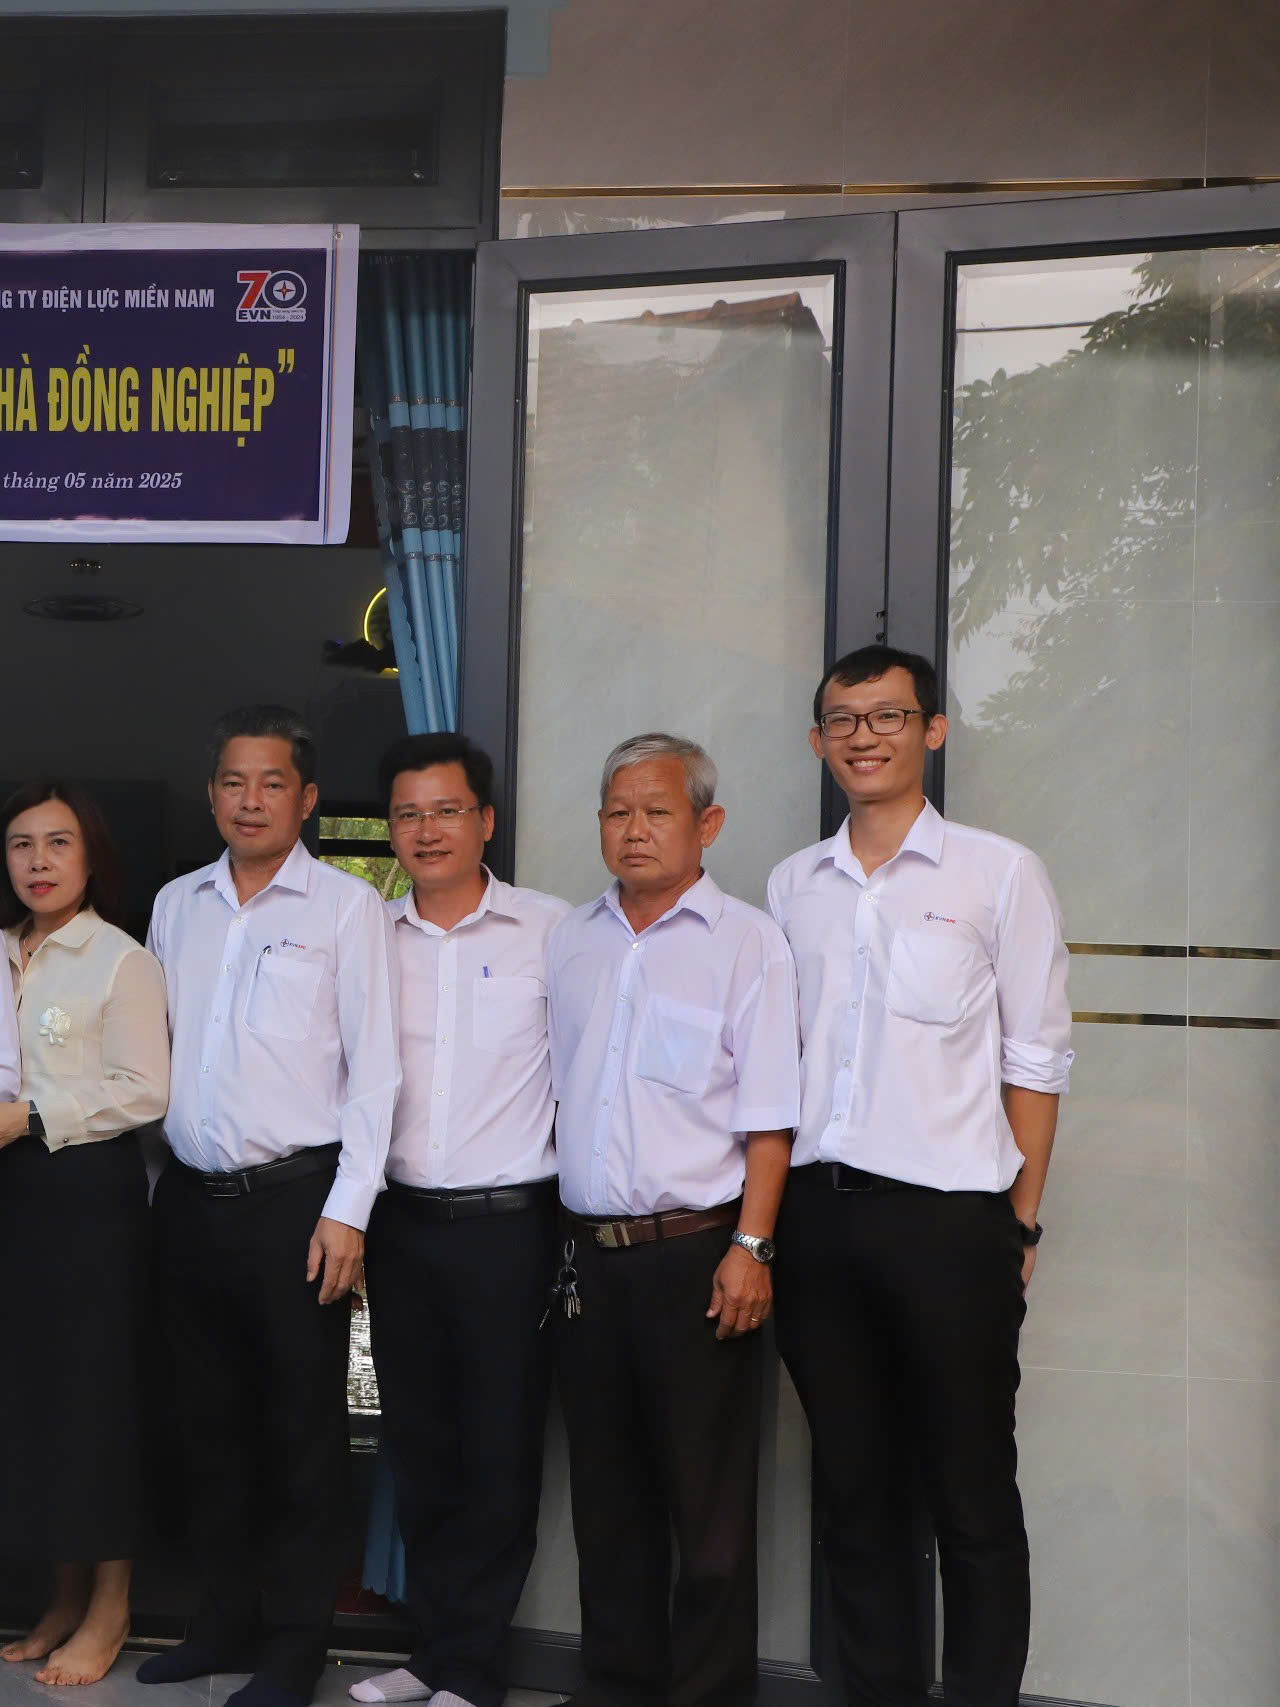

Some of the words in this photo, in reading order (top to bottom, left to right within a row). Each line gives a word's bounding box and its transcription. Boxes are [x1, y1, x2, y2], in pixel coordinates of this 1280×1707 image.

[17, 289, 37, 309] TY
[42, 285, 82, 312] ĐIỆN
[87, 287, 119, 312] LỰC
[124, 282, 169, 308] MIỀN
[174, 288, 215, 308] NAM
[238, 309, 271, 320] EVN
[47, 344, 140, 433] ĐỒNG
[2, 471, 61, 493] tháng
[64, 471, 86, 489] 05
[90, 472, 134, 489] năm
[138, 471, 183, 489] 2025
